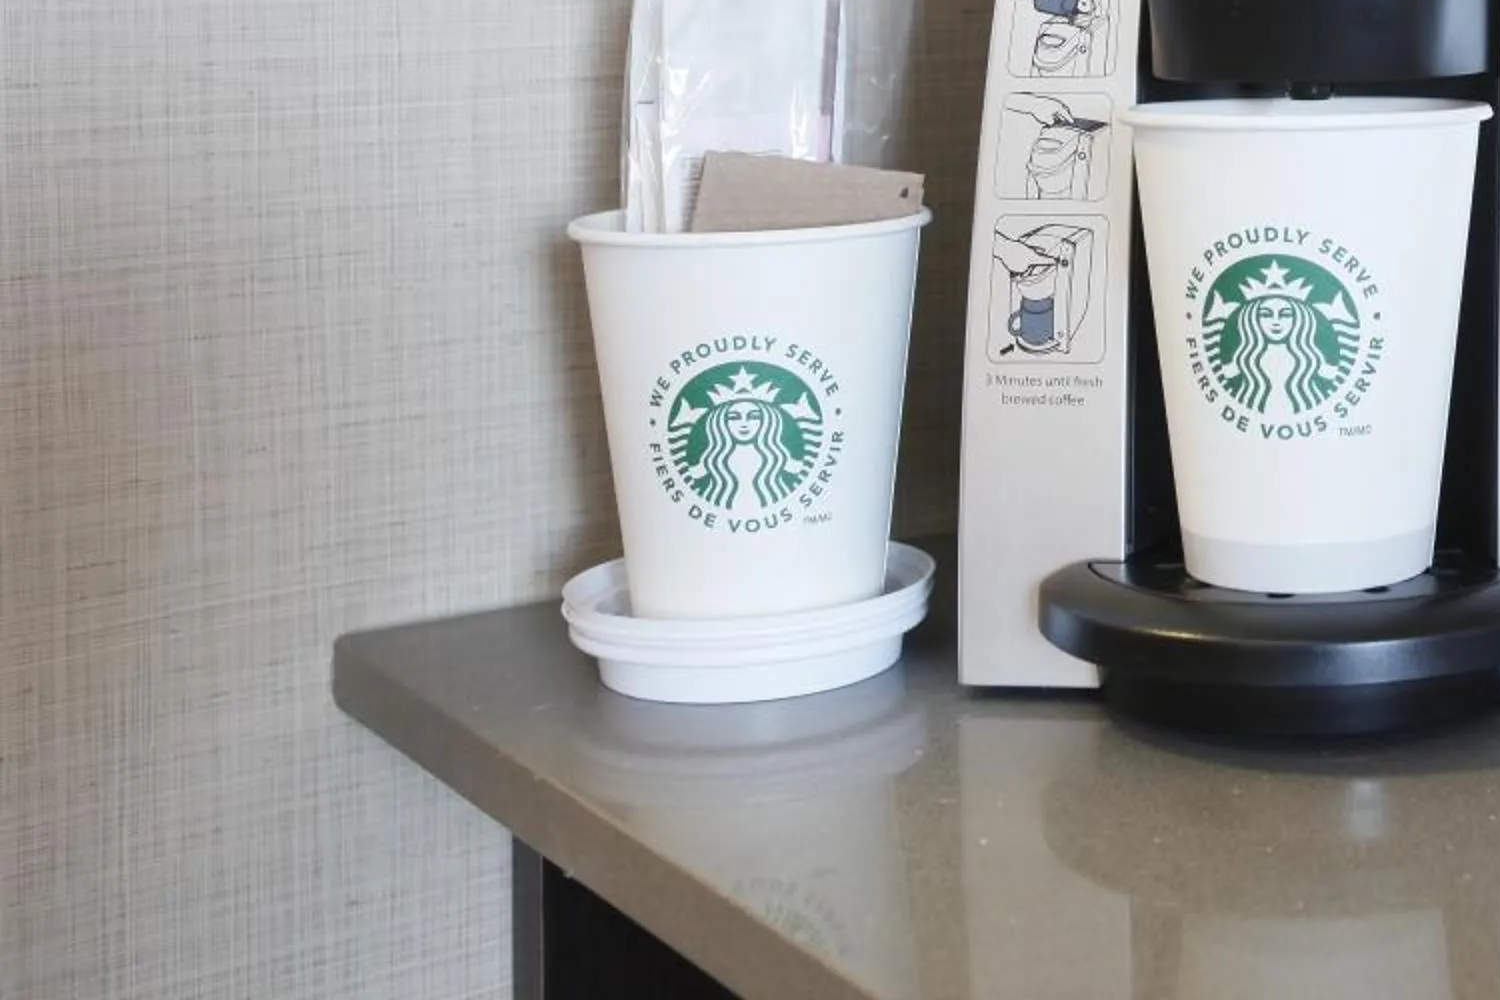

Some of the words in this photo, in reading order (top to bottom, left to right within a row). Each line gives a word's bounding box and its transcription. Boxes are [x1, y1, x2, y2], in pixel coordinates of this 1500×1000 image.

[1185, 267, 1205, 300] WE
[1203, 227, 1310, 264] PROUDLY
[1318, 238, 1379, 300] SERVE
[650, 377, 670, 407] WE
[670, 336, 777, 375] PROUDLY
[786, 344, 839, 396] SERVE
[995, 375, 1042, 387] Minutes
[1045, 375, 1071, 387] until
[1001, 393, 1046, 405] brewed
[1048, 394, 1085, 406] coffee
[1186, 337, 1219, 403] FIERS
[1221, 405, 1250, 432] DE
[1261, 416, 1328, 441] VOUS
[1334, 336, 1385, 418] SERVIR
[649, 443, 684, 503] FIERS
[688, 504, 717, 528] DE
[728, 507, 793, 533] VOUS
[799, 431, 845, 508] SERVIR
